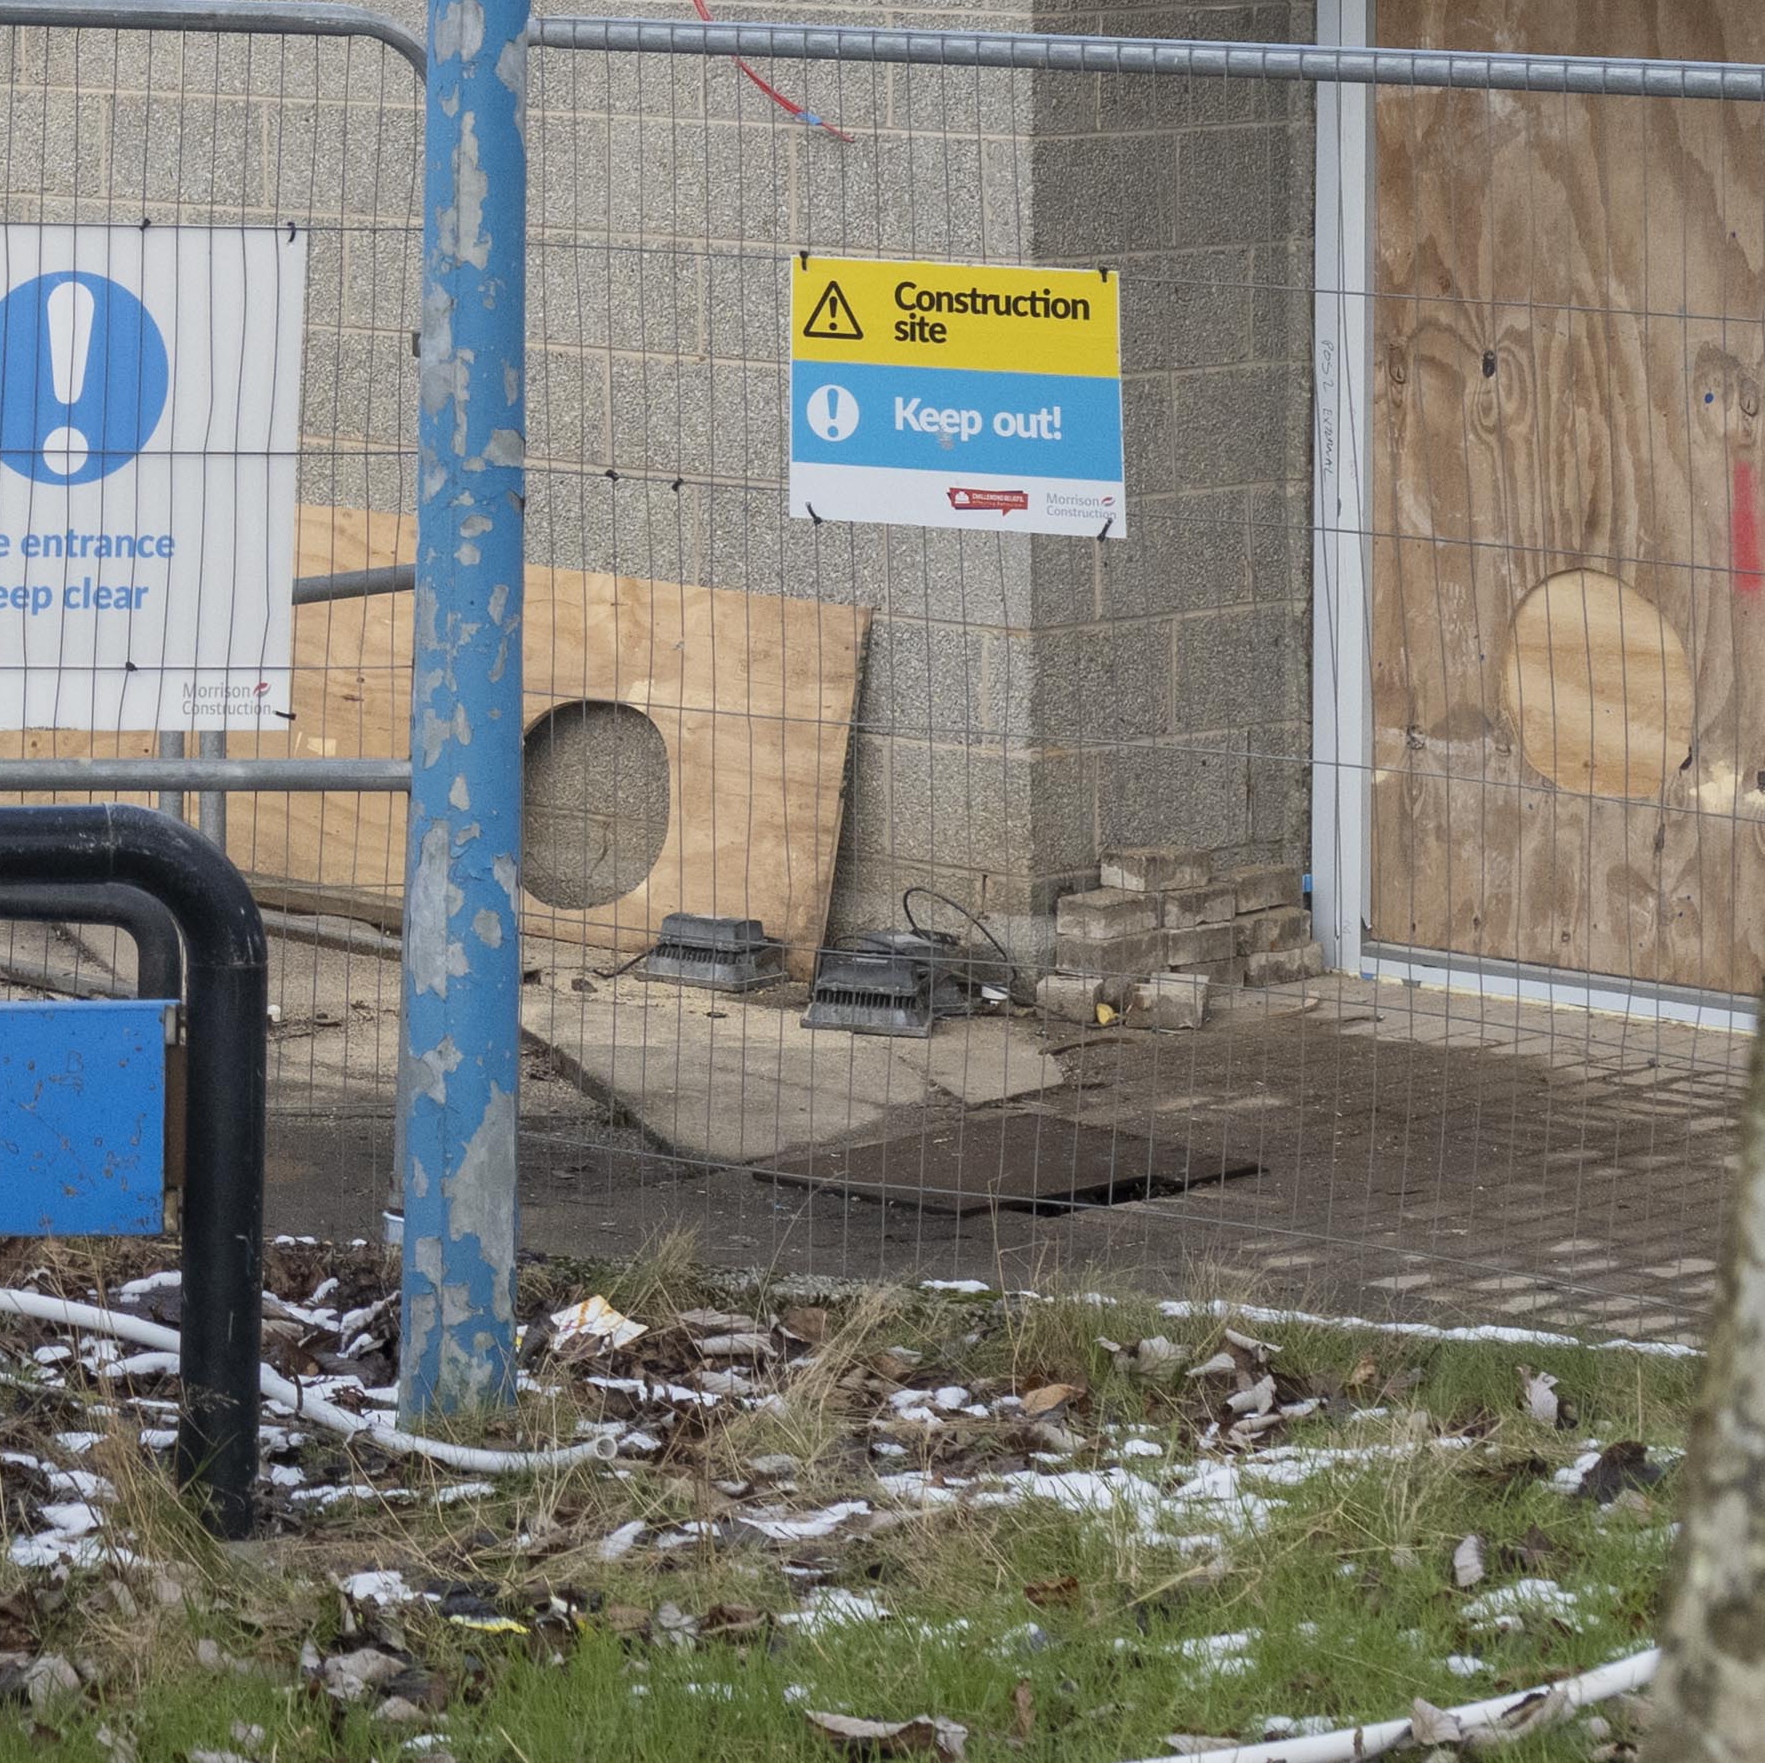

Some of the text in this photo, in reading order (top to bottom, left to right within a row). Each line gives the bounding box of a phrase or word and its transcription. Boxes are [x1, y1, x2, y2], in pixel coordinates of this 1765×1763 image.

[894, 281, 1091, 321] Construction
[894, 312, 947, 344] site
[894, 396, 1063, 442] Keep out!
[1046, 492, 1100, 507] Morrison
[1046, 505, 1117, 520] Construction
[20, 527, 176, 559] entrance
[62, 576, 150, 611] clear
[182, 682, 251, 699] Morrison
[182, 700, 271, 716] Construction
